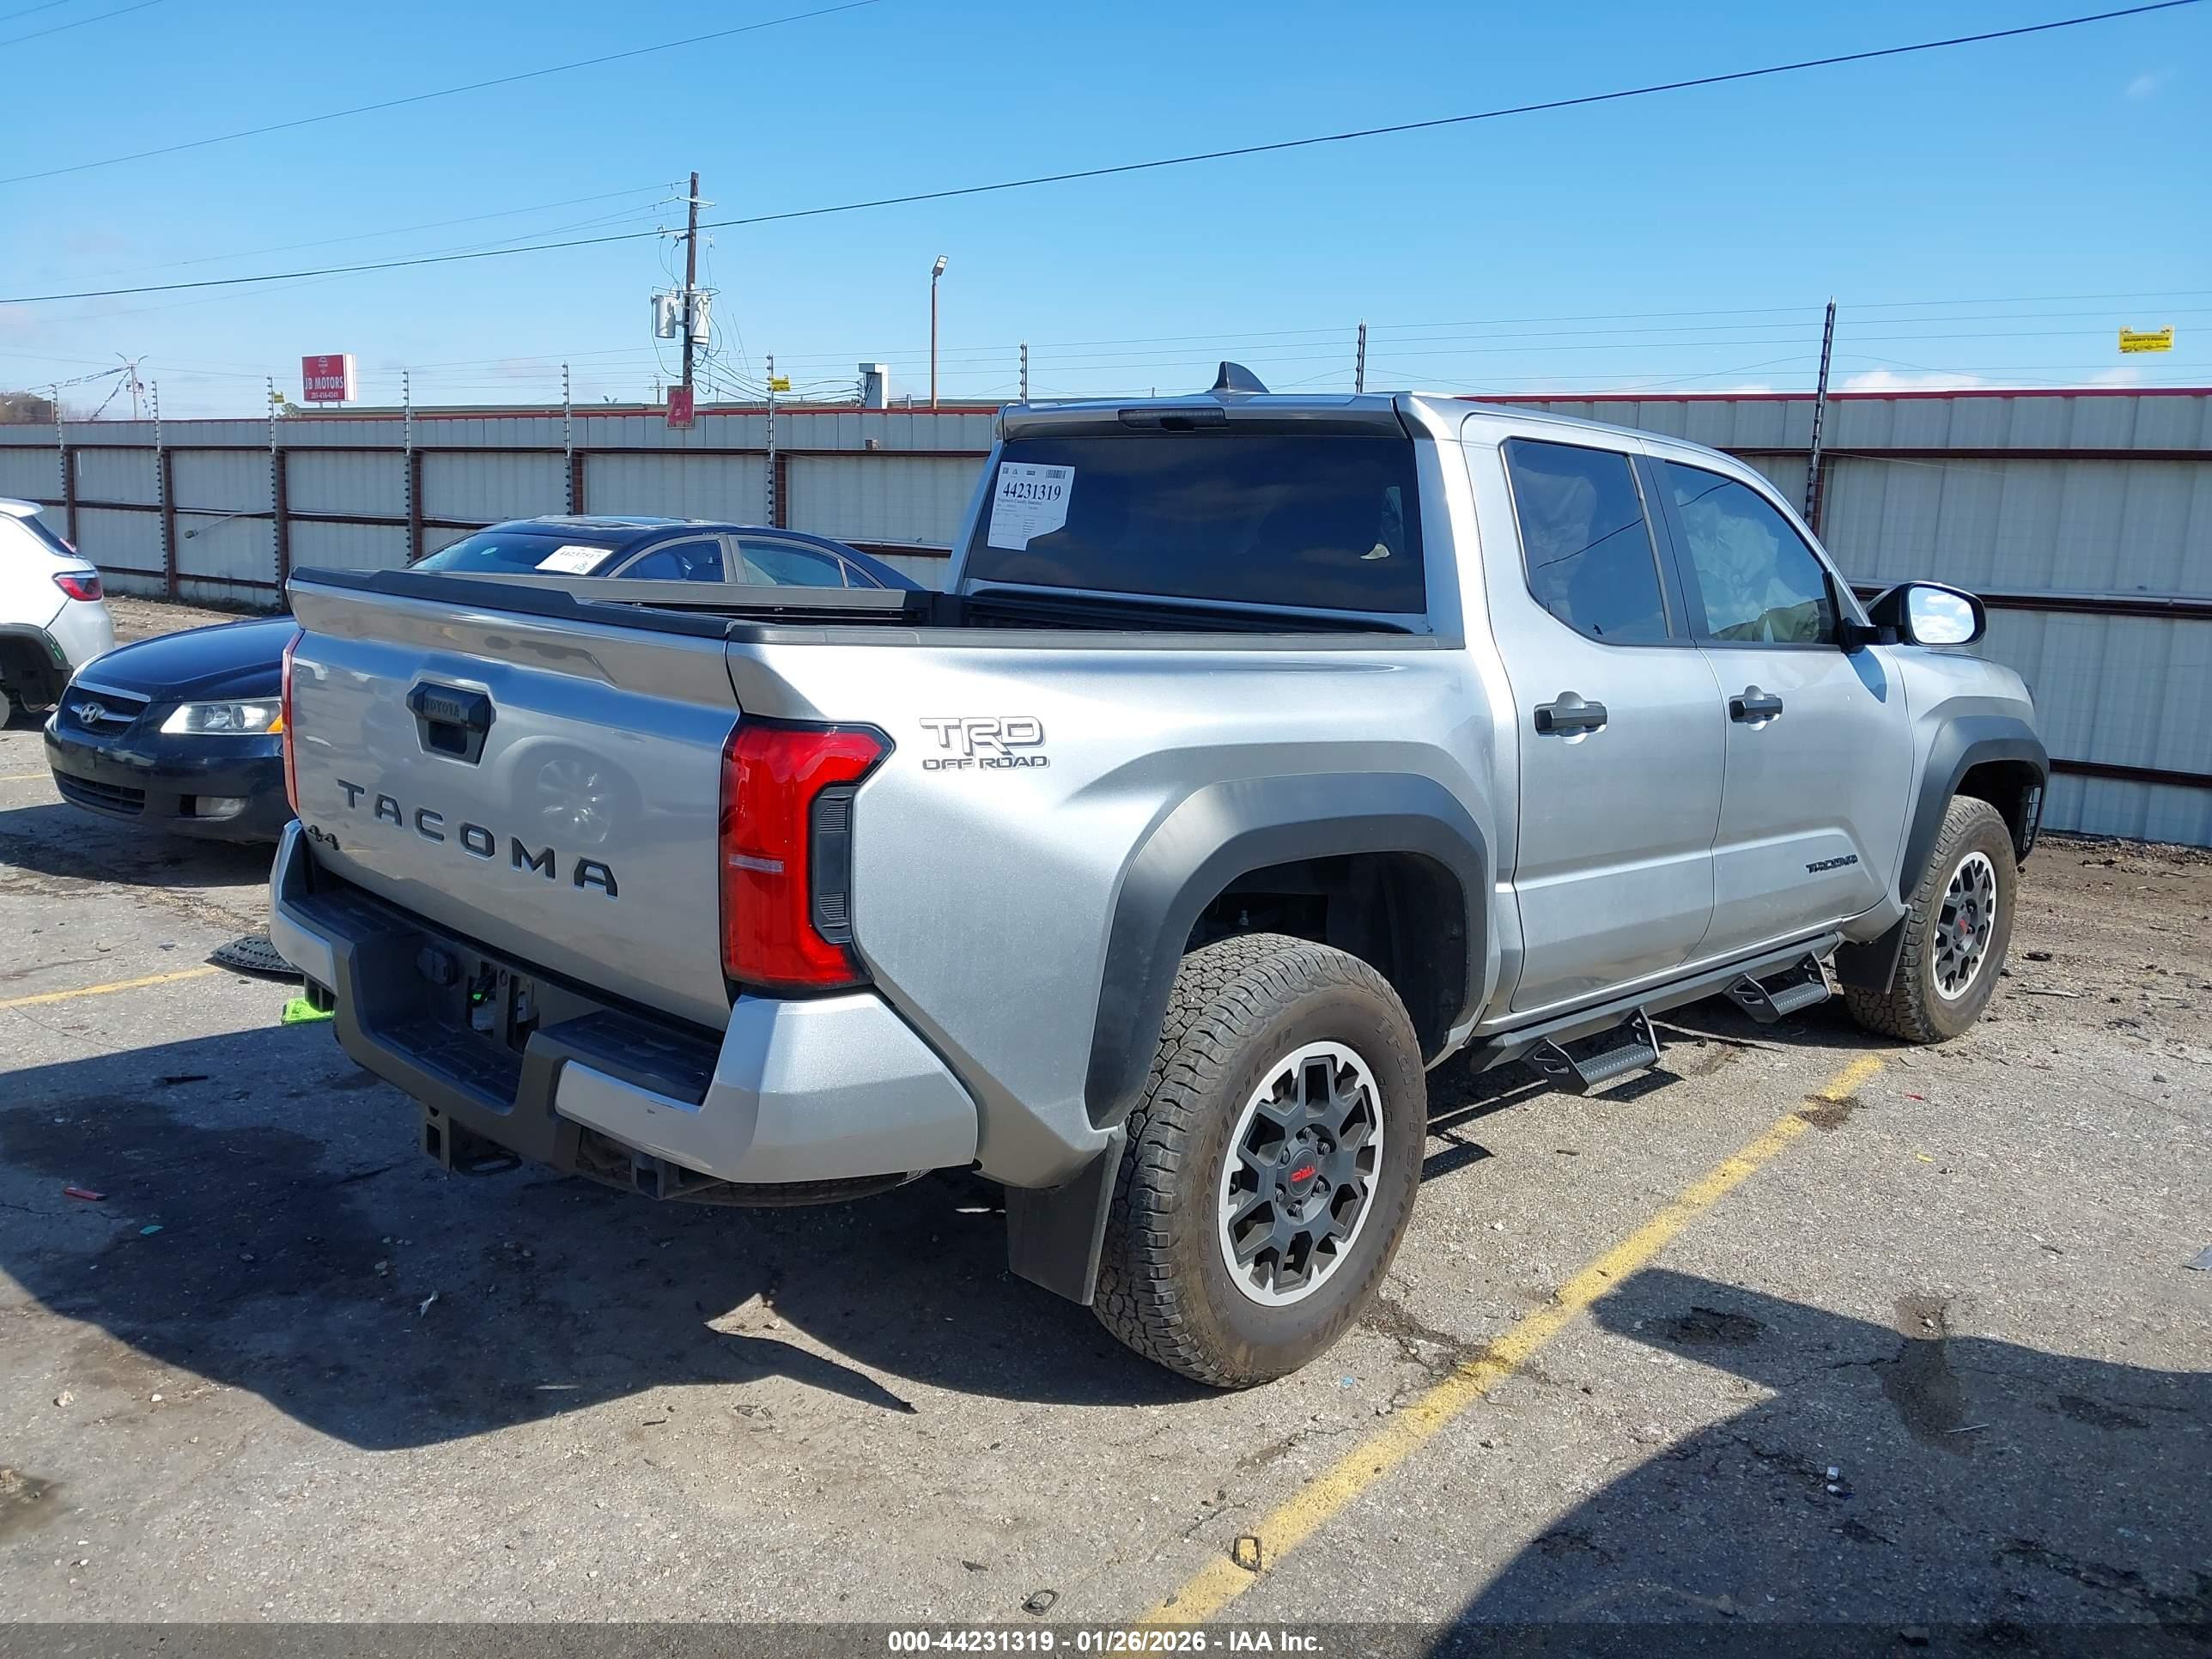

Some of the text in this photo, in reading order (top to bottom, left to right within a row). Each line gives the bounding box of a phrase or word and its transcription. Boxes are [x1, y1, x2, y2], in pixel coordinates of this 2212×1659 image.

[305, 376, 344, 390] JB MOTORS
[1002, 481, 1062, 501] 44231319
[425, 698, 461, 718] TOYOTA
[919, 716, 1045, 757] TRD
[922, 756, 1048, 770] OFF ROAD
[336, 777, 620, 898] TACOMA
